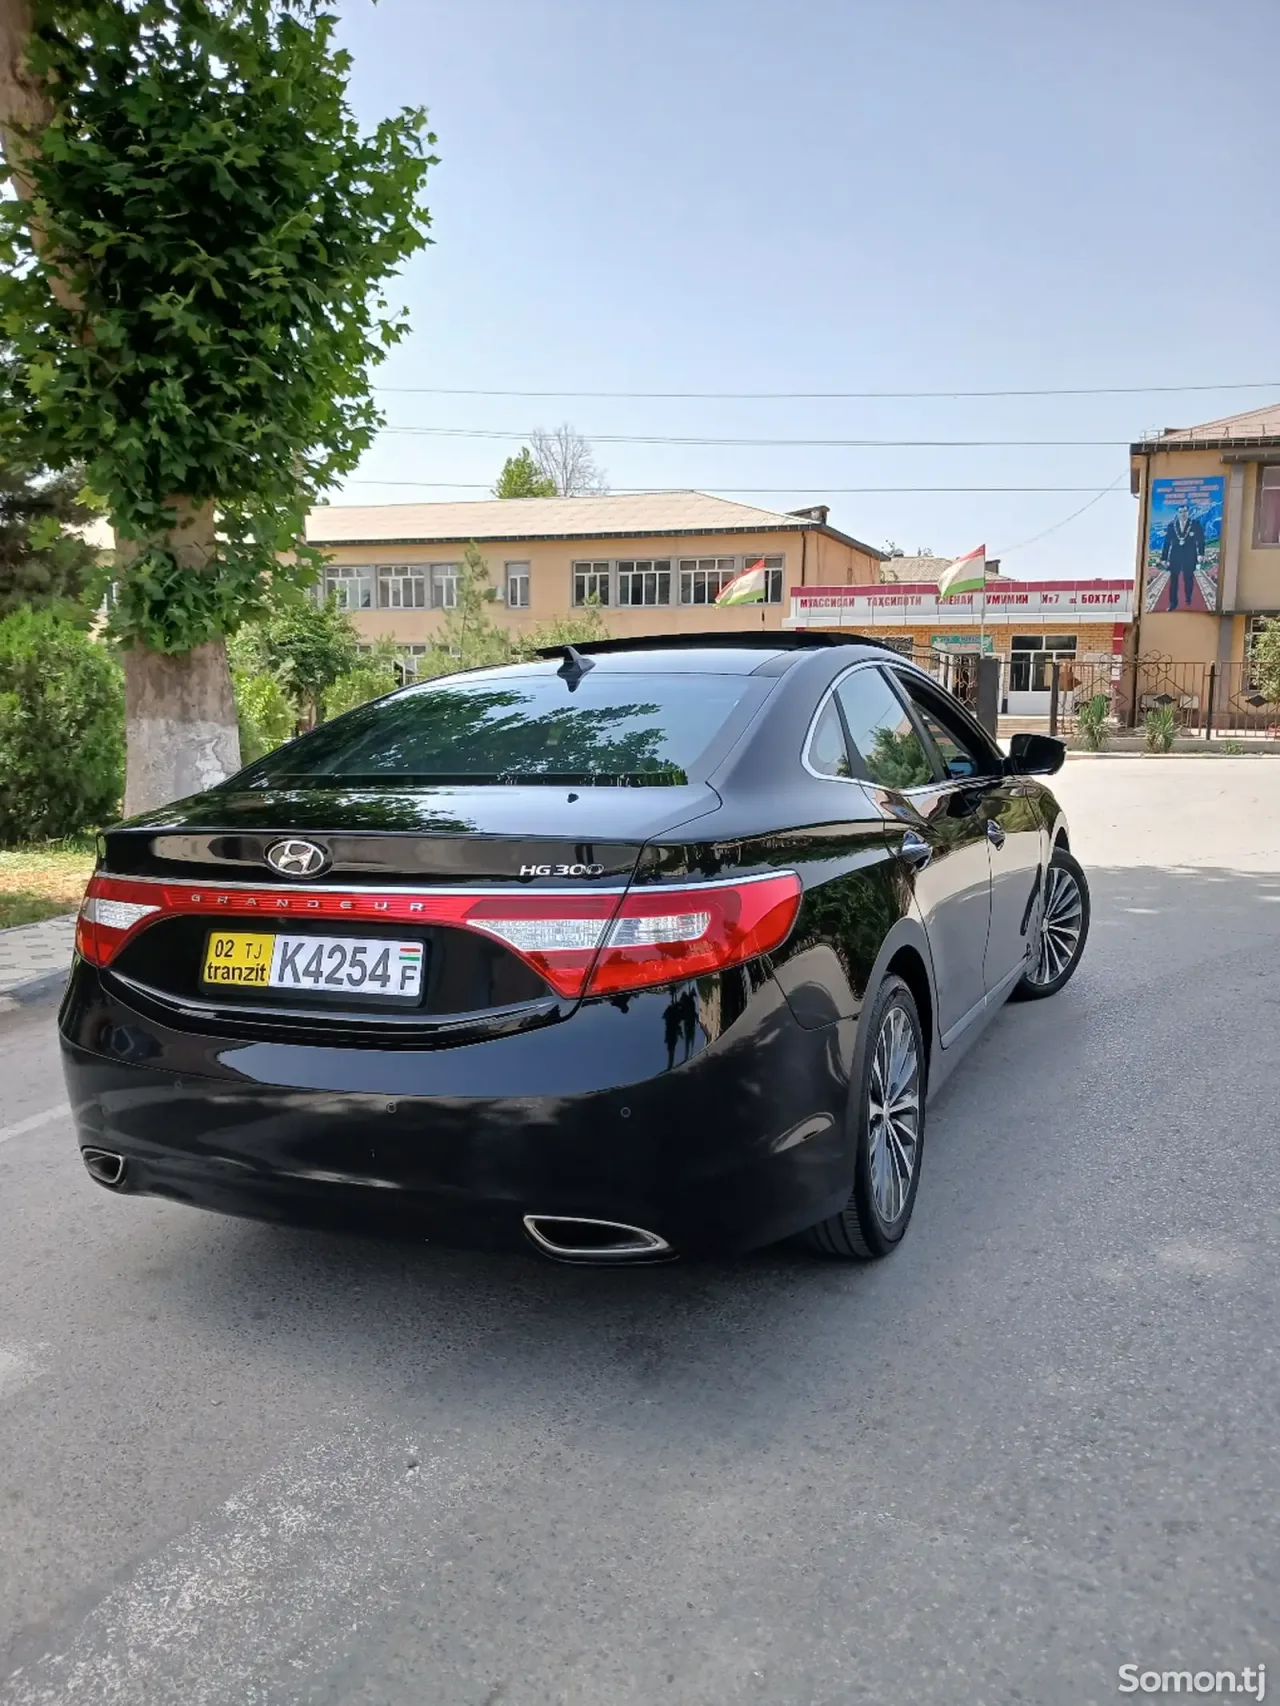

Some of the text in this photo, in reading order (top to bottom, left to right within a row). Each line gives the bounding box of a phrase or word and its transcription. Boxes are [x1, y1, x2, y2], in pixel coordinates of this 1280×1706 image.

[1081, 593, 1121, 604] БОХТАР
[519, 863, 605, 876] HG 300
[191, 893, 425, 912] GRANDEUR
[215, 939, 263, 959] 02 TJ
[207, 962, 267, 982] tranzit
[278, 941, 391, 988] K4254
[399, 965, 418, 990] F
